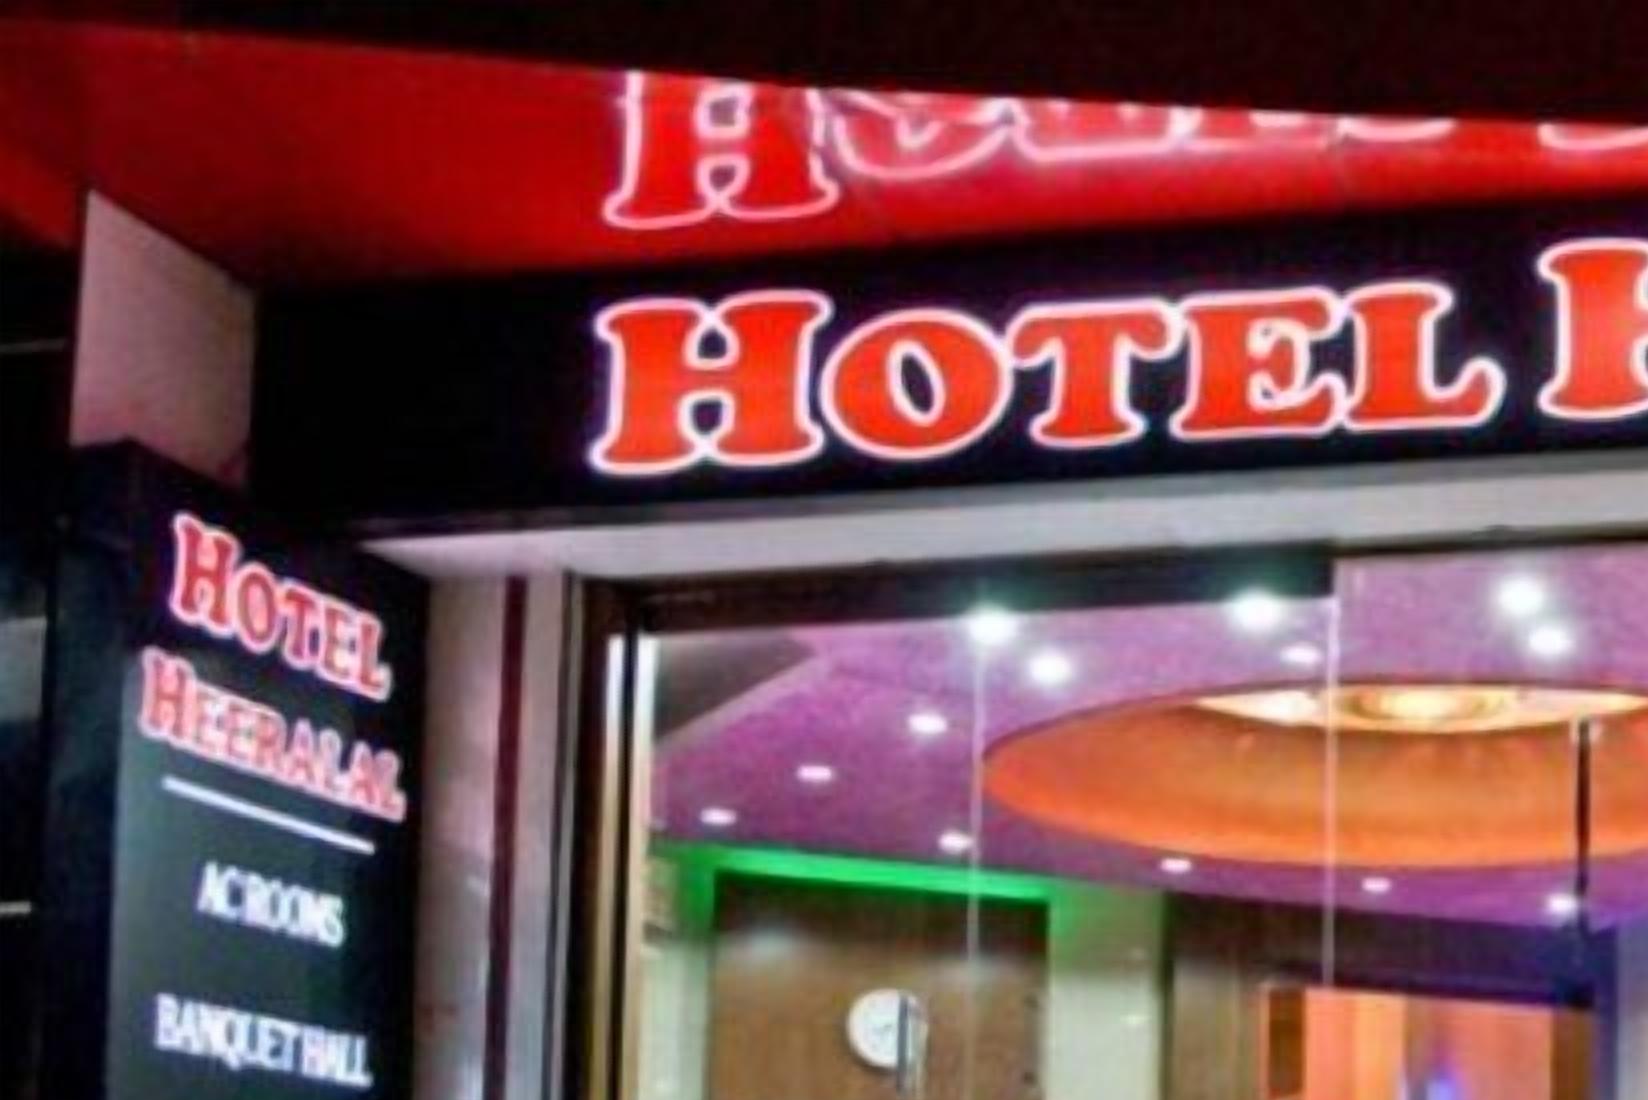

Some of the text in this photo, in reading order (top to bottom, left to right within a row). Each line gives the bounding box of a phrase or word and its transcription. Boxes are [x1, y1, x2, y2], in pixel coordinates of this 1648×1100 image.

[590, 281, 1505, 476] HOTEL
[169, 511, 392, 701] HOTEL
[138, 646, 405, 822] HEERALAL
[153, 992, 372, 1088] BANQUET HALL
